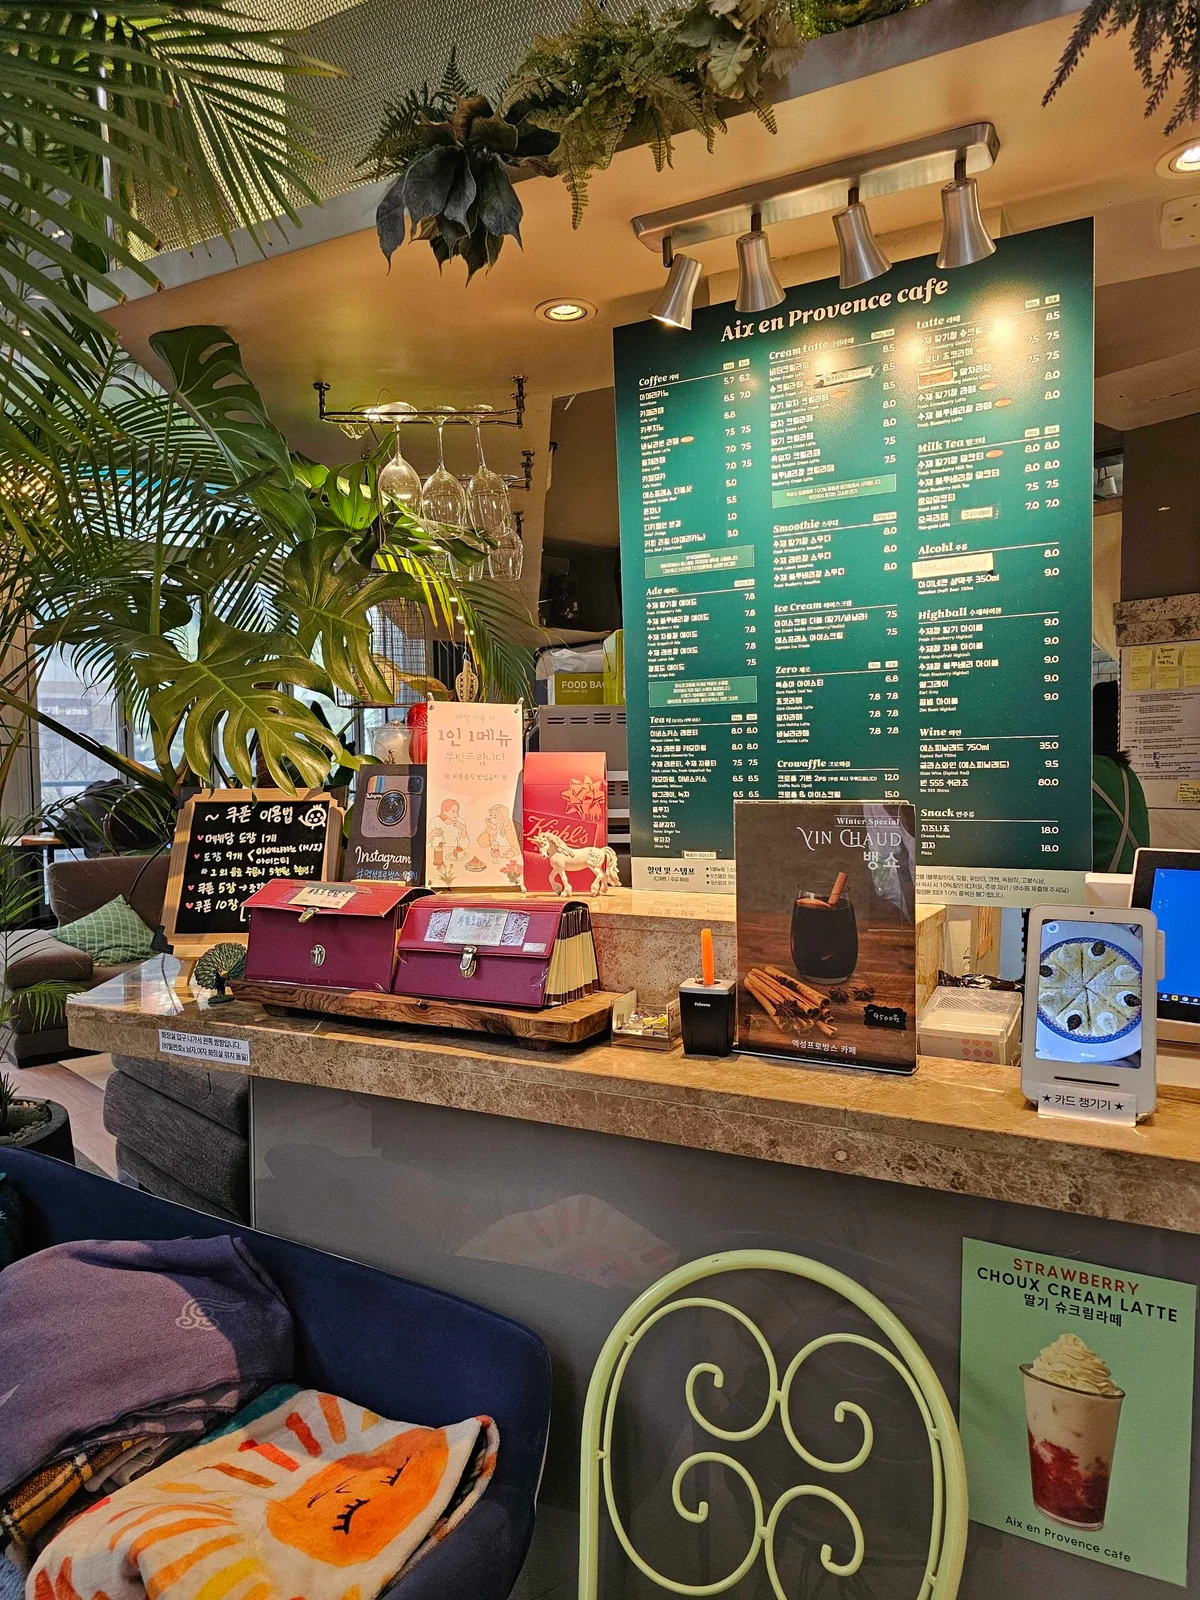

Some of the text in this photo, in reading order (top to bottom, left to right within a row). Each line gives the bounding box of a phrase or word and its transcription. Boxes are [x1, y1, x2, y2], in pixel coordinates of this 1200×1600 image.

[721, 277, 949, 342] Aix en Provence cafe
[1046, 311, 1060, 321] 8.5
[917, 318, 945, 329] Latte
[769, 342, 828, 360] Cream Latte
[883, 344, 895, 353] 8.5
[883, 363, 895, 372] 8.5
[639, 375, 667, 386] Coffee
[724, 373, 750, 385] 5.7 6.2
[1044, 371, 1060, 380] 8.0
[740, 391, 751, 399] 7.0
[883, 400, 896, 409] 8.0
[918, 442, 942, 453] Milk
[945, 440, 964, 448] Tea
[1025, 441, 1060, 453] 8.0 8.0
[726, 479, 737, 487] 5.0
[1025, 499, 1060, 510] 7.0 7.0
[773, 519, 820, 533] Smoothie
[883, 527, 897, 535] 8.0
[884, 545, 897, 553] 8.0
[918, 542, 953, 554] Alcohl
[1044, 549, 1059, 557] 8.0
[1044, 568, 1059, 576] 9.0
[976, 574, 999, 583] 350ml
[646, 587, 662, 595] Ade
[774, 605, 788, 613] Ice
[790, 602, 822, 611] Cream
[919, 607, 967, 621] Highball
[1044, 618, 1059, 626] 9.0
[1044, 637, 1059, 645] 9.0
[562, 681, 587, 689] FOOD
[1044, 693, 1059, 701] 9.0
[456, 714, 470, 722] 매장
[473, 715, 486, 723] 이용
[650, 716, 664, 724] Tea
[920, 727, 946, 736] Wine
[439, 727, 512, 747] 1인 1메뉴
[445, 752, 505, 765] 부탁드립니다
[777, 760, 826, 769] Crowaffle
[1045, 760, 1059, 768] 9.5
[226, 805, 293, 823] 쿠폰 이용법
[921, 808, 954, 818] Snack
[868, 818, 899, 826] Special
[205, 832, 277, 845] 메뉴당 도장 1개
[796, 827, 901, 850] VIN CHAUD
[204, 852, 221, 862] 도장
[226, 851, 242, 860] 9개
[355, 846, 412, 869] Instagram
[647, 866, 662, 875] 할인
[673, 867, 695, 875] 스탬프
[198, 882, 237, 894] 쿠폰 5장
[195, 899, 238, 913] 쿠폰 10장
[187, 1035, 202, 1044] 나가서
[203, 1037, 213, 1045] 왼쪽
[208, 1049, 223, 1058] 화장실
[225, 1051, 235, 1059] 위치
[841, 1046, 856, 1055] 카페
[1055, 1095, 1110, 1110] 카드 챙기기
[1013, 1258, 1139, 1296] STRAWBERRY
[977, 1267, 1178, 1322] CHOUX CREAM LATTE
[1024, 1294, 1122, 1327] 딸기 슈크림라떼
[1006, 1515, 1132, 1563] Aix en Provence cafe
